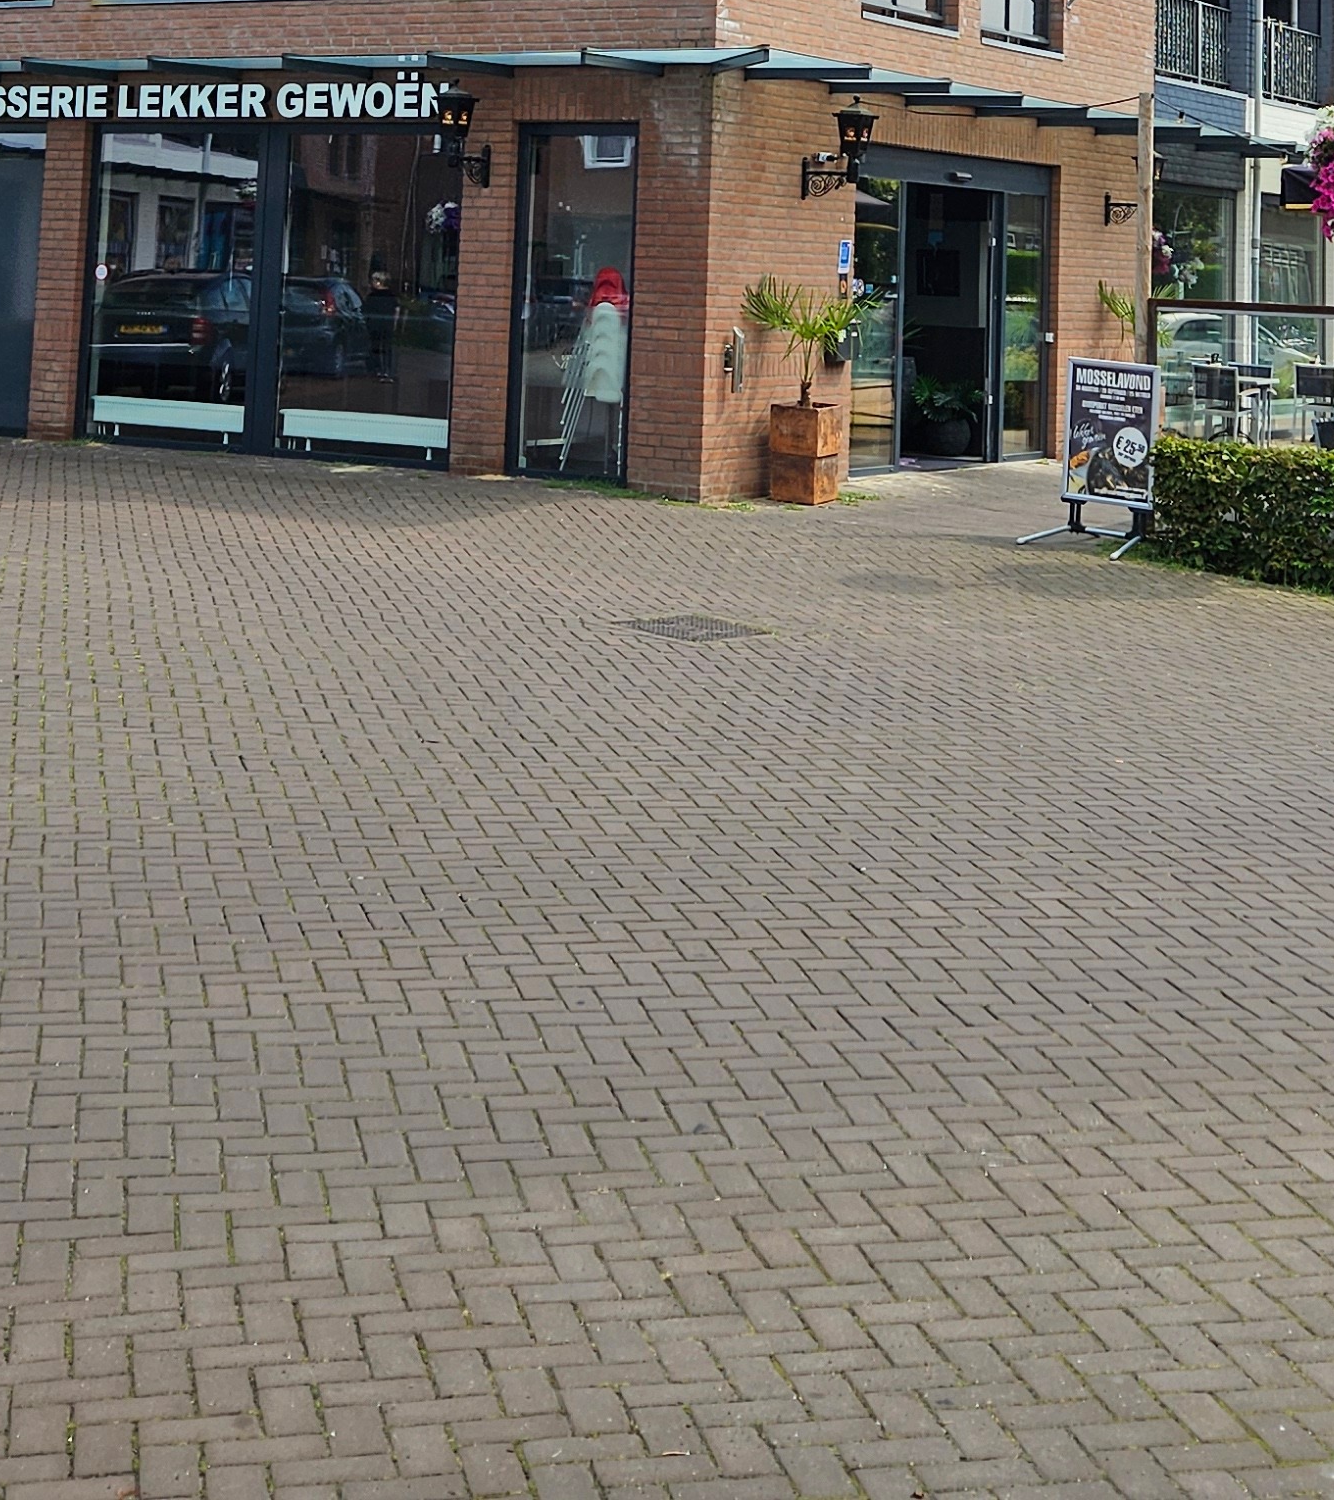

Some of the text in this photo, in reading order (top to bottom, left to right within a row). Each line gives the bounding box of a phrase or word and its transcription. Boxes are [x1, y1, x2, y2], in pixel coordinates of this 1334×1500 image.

[118, 83, 267, 117] LEKKER
[276, 71, 450, 118] GEWOËN
[1075, 367, 1151, 391] MOSSELAVOND
